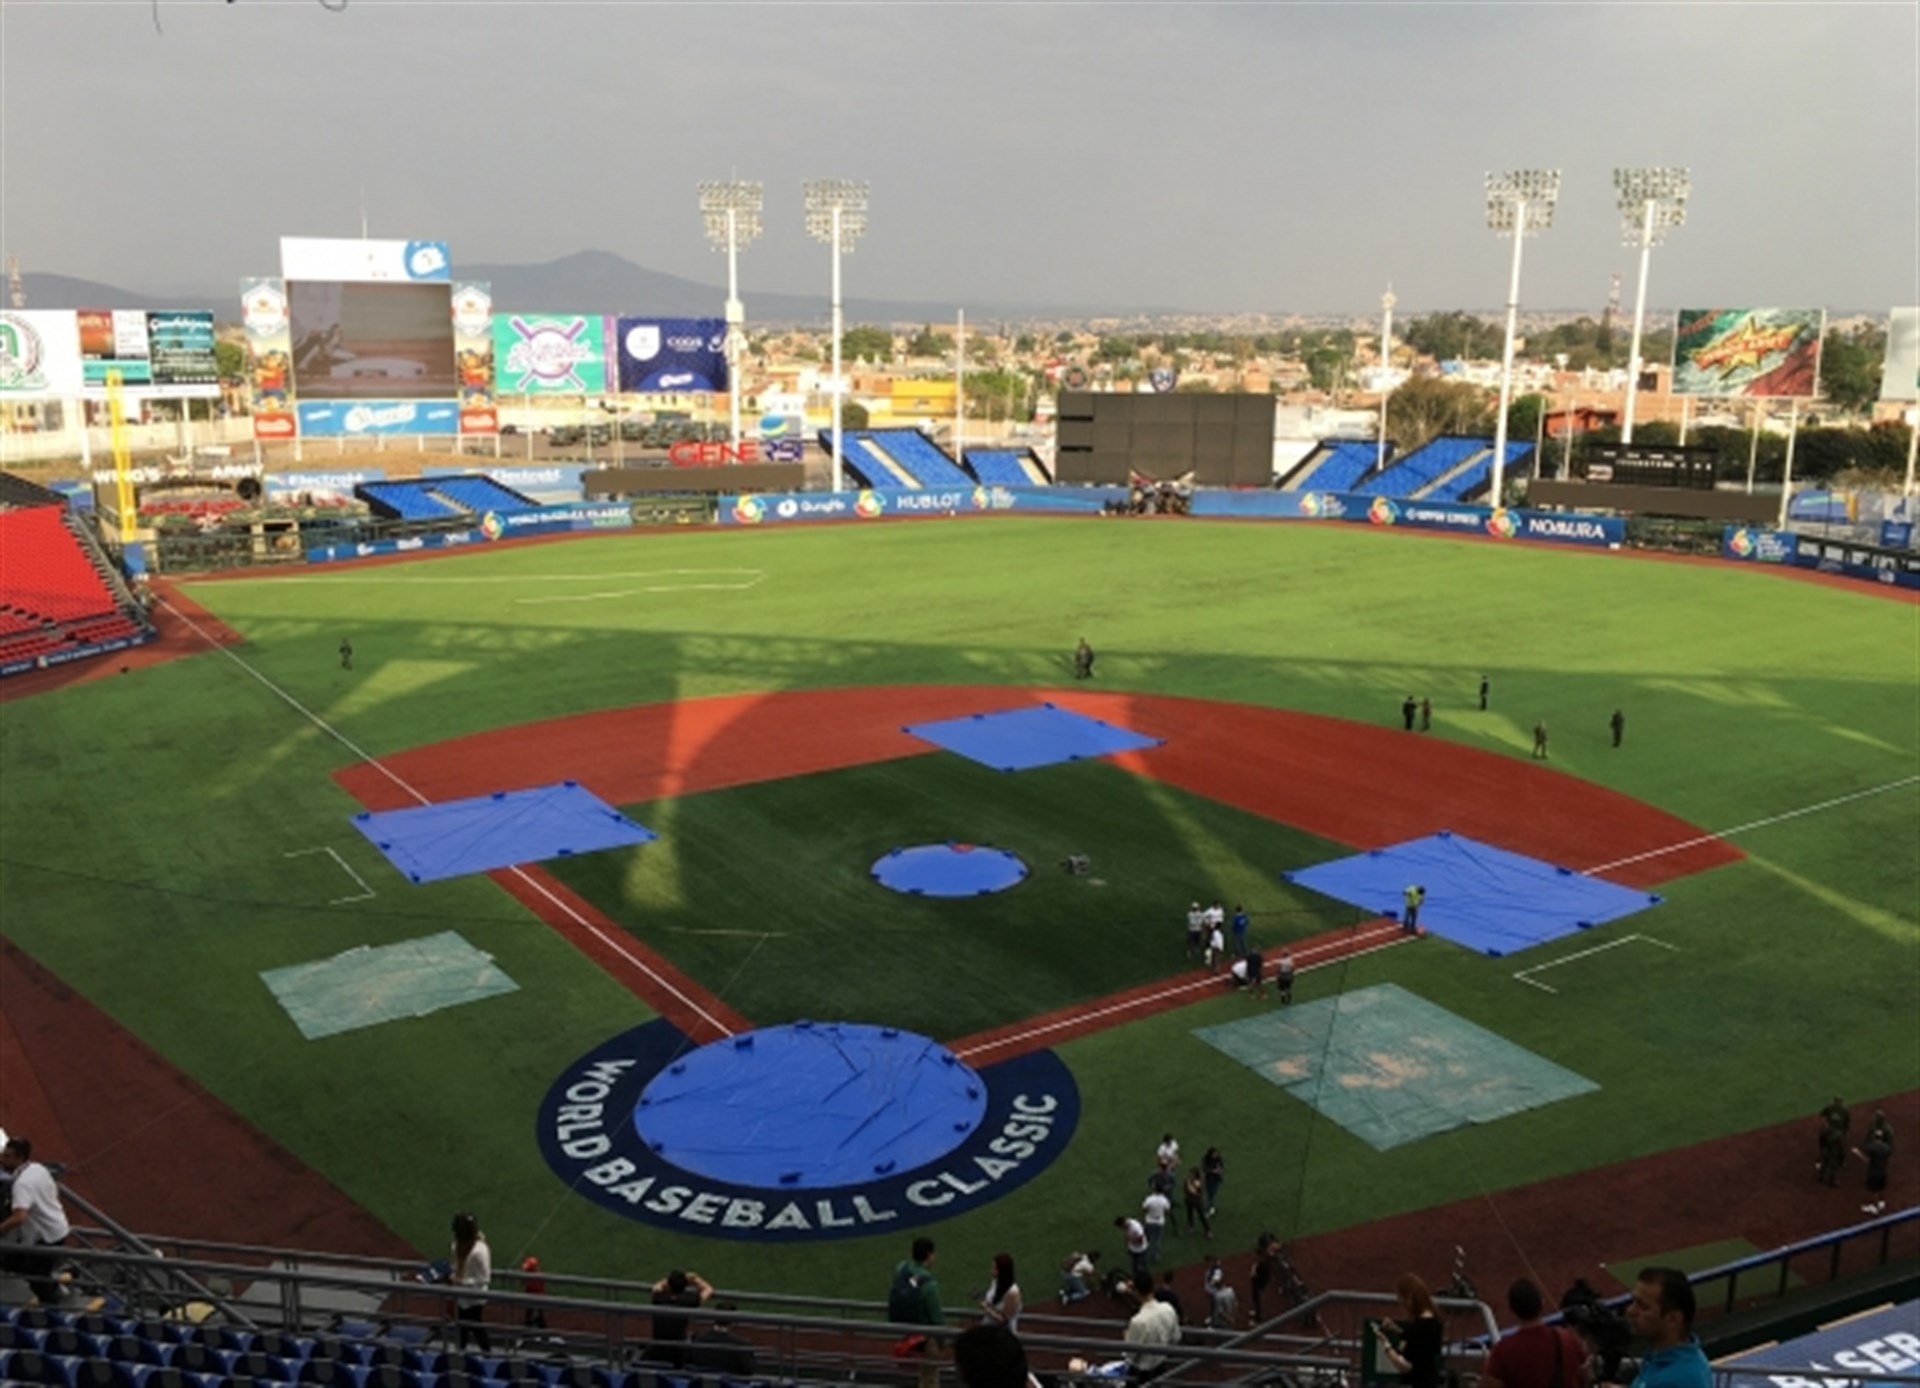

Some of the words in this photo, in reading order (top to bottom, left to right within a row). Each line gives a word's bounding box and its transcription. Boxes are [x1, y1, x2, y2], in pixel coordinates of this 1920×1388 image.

[896, 493, 962, 509] HUBLOT
[1528, 518, 1606, 539] NOMURA
[557, 1058, 636, 1160] WORLD
[906, 1093, 1058, 1208] CLASSIC
[583, 1158, 898, 1230] BASEBALL
